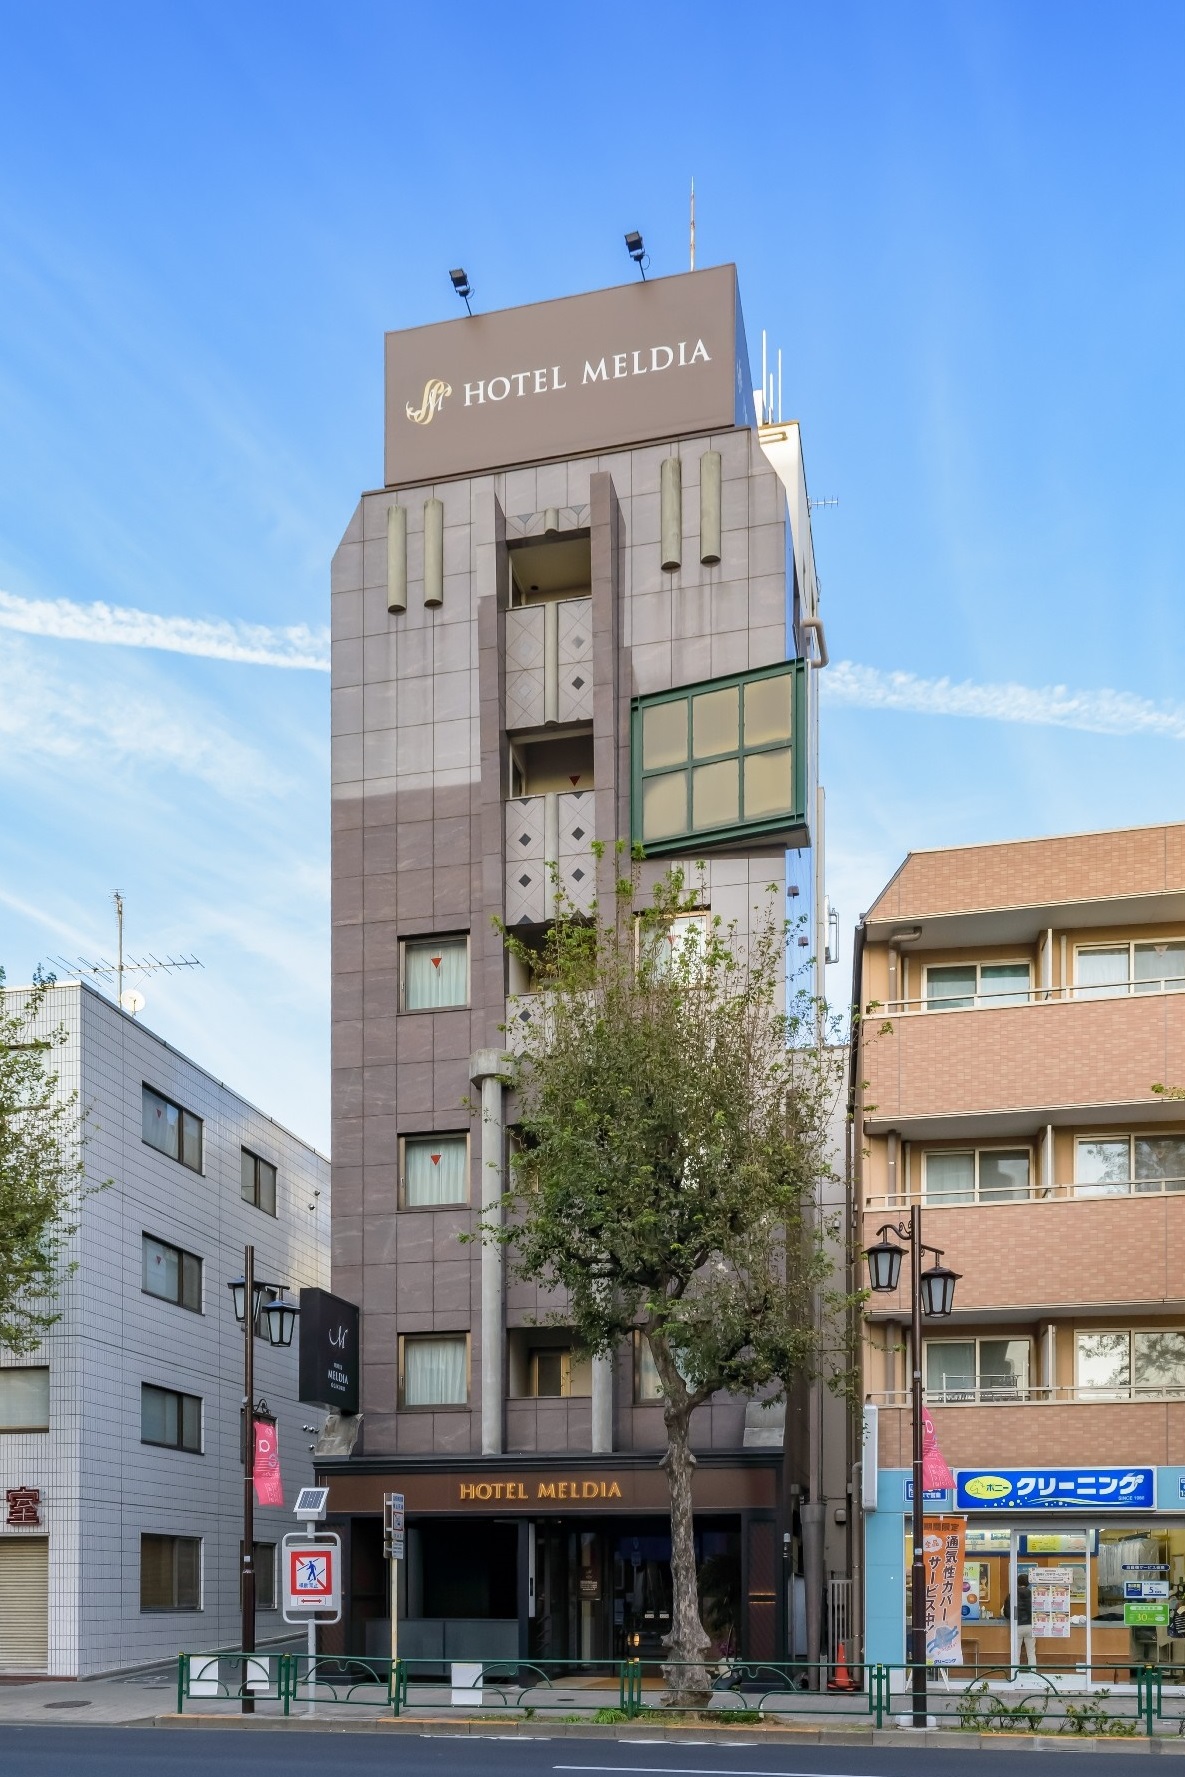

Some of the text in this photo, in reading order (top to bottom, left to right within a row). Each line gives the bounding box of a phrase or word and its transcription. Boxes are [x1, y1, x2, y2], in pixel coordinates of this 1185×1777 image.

[463, 365, 567, 407] HOTEL
[582, 338, 712, 385] MELDIA
[327, 1369, 349, 1385] MELDIA
[459, 1481, 623, 1500] HOTEL MELDIA
[1016, 1475, 1145, 1496] クリーニング
[6, 1487, 40, 1524] 室
[924, 1522, 960, 1532] 期間限定
[939, 1535, 960, 1621] 通気性カバー
